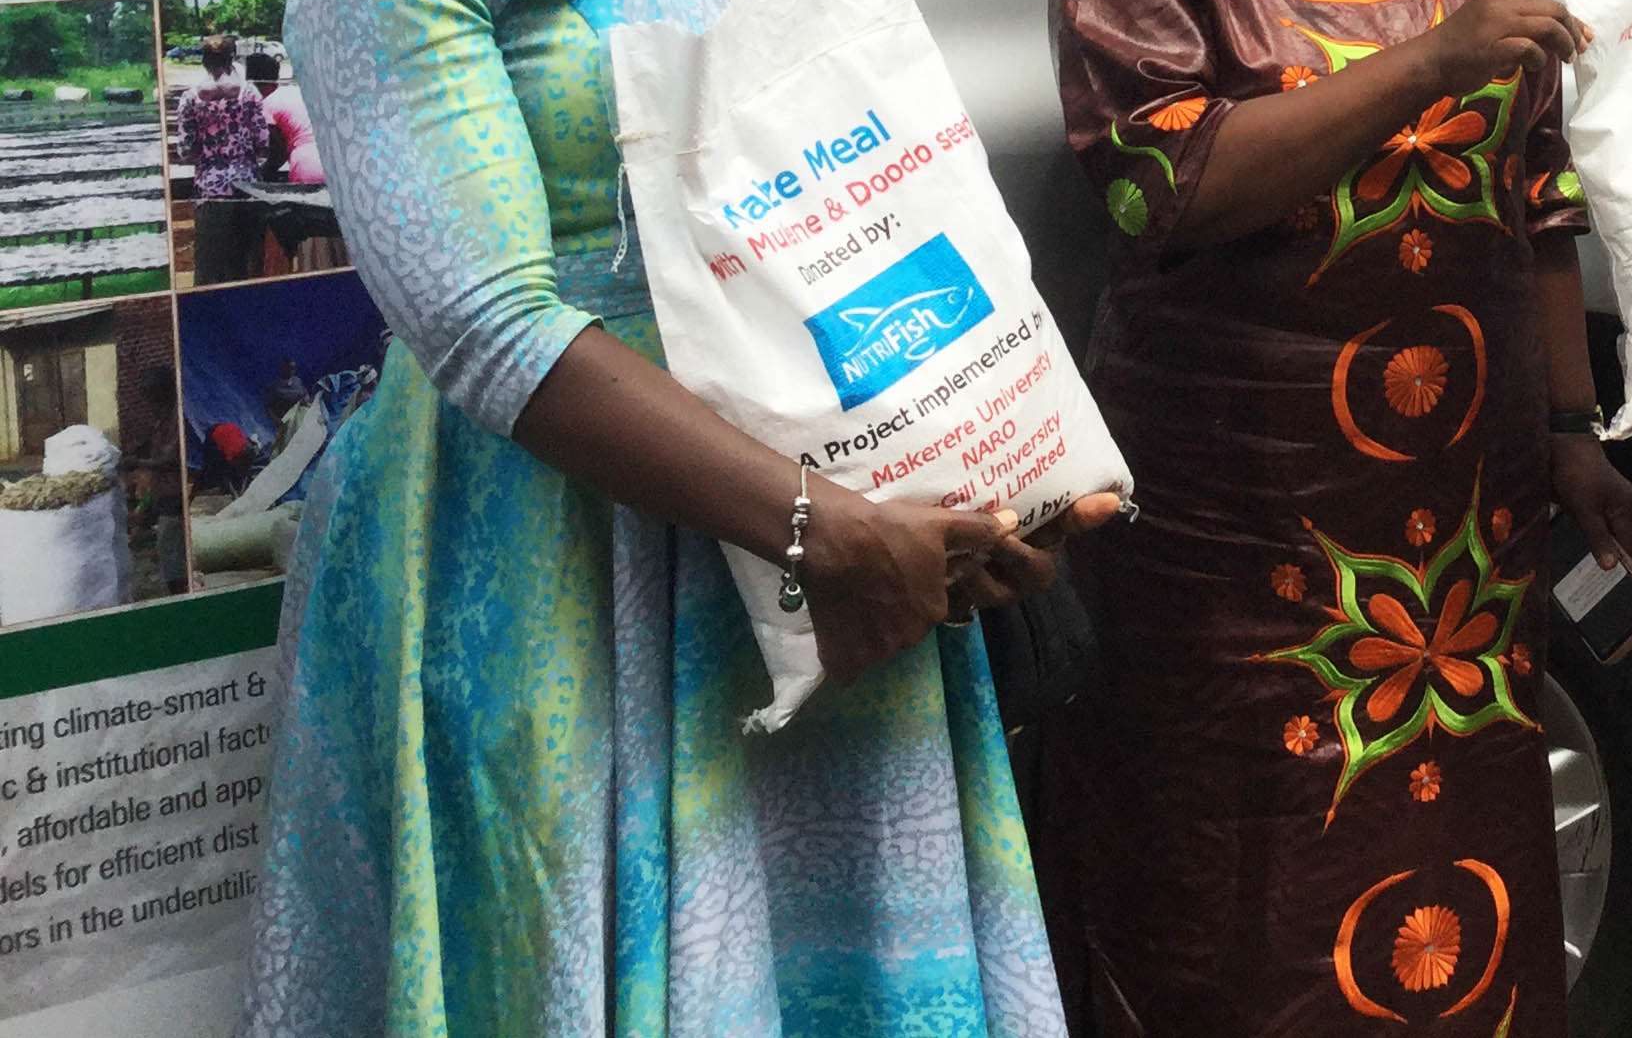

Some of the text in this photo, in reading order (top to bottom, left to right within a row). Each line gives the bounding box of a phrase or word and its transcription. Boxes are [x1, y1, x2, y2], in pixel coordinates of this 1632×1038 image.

[803, 109, 892, 181] Meal
[823, 144, 933, 222] & Doodo
[860, 212, 902, 245] by:
[824, 322, 1032, 462] Project implemented
[871, 350, 1052, 490] Makerere University
[961, 419, 1016, 471] NARO
[980, 410, 1062, 487] University
[1006, 438, 1067, 500] Limited
[53, 672, 267, 739] climate-smart &
[26, 732, 210, 794] & institutional
[17, 774, 262, 848] affordable and app
[55, 823, 260, 891] for efficient dist
[49, 904, 124, 943] in the
